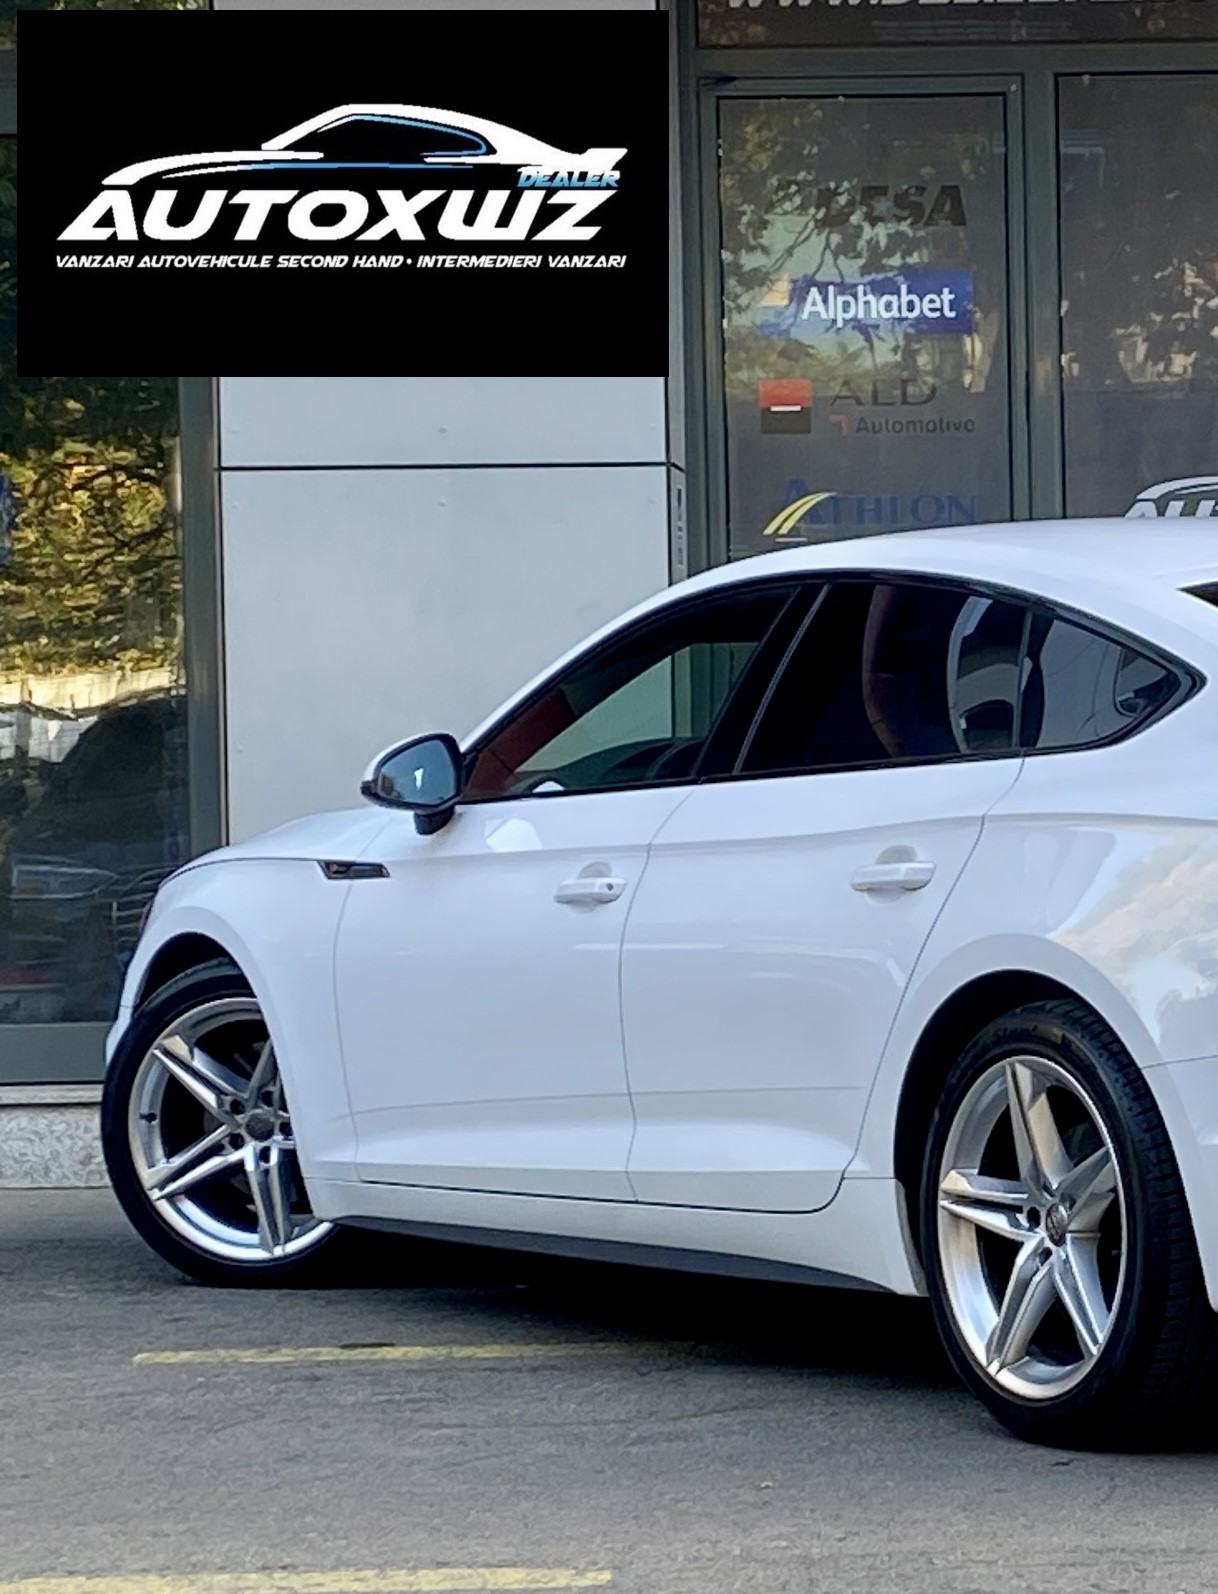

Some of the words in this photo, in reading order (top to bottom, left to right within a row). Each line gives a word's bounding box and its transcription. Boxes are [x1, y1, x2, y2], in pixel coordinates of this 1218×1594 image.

[800, 284, 957, 328] Alphabet
[830, 377, 938, 407] ALD
[855, 416, 976, 435] Automotive
